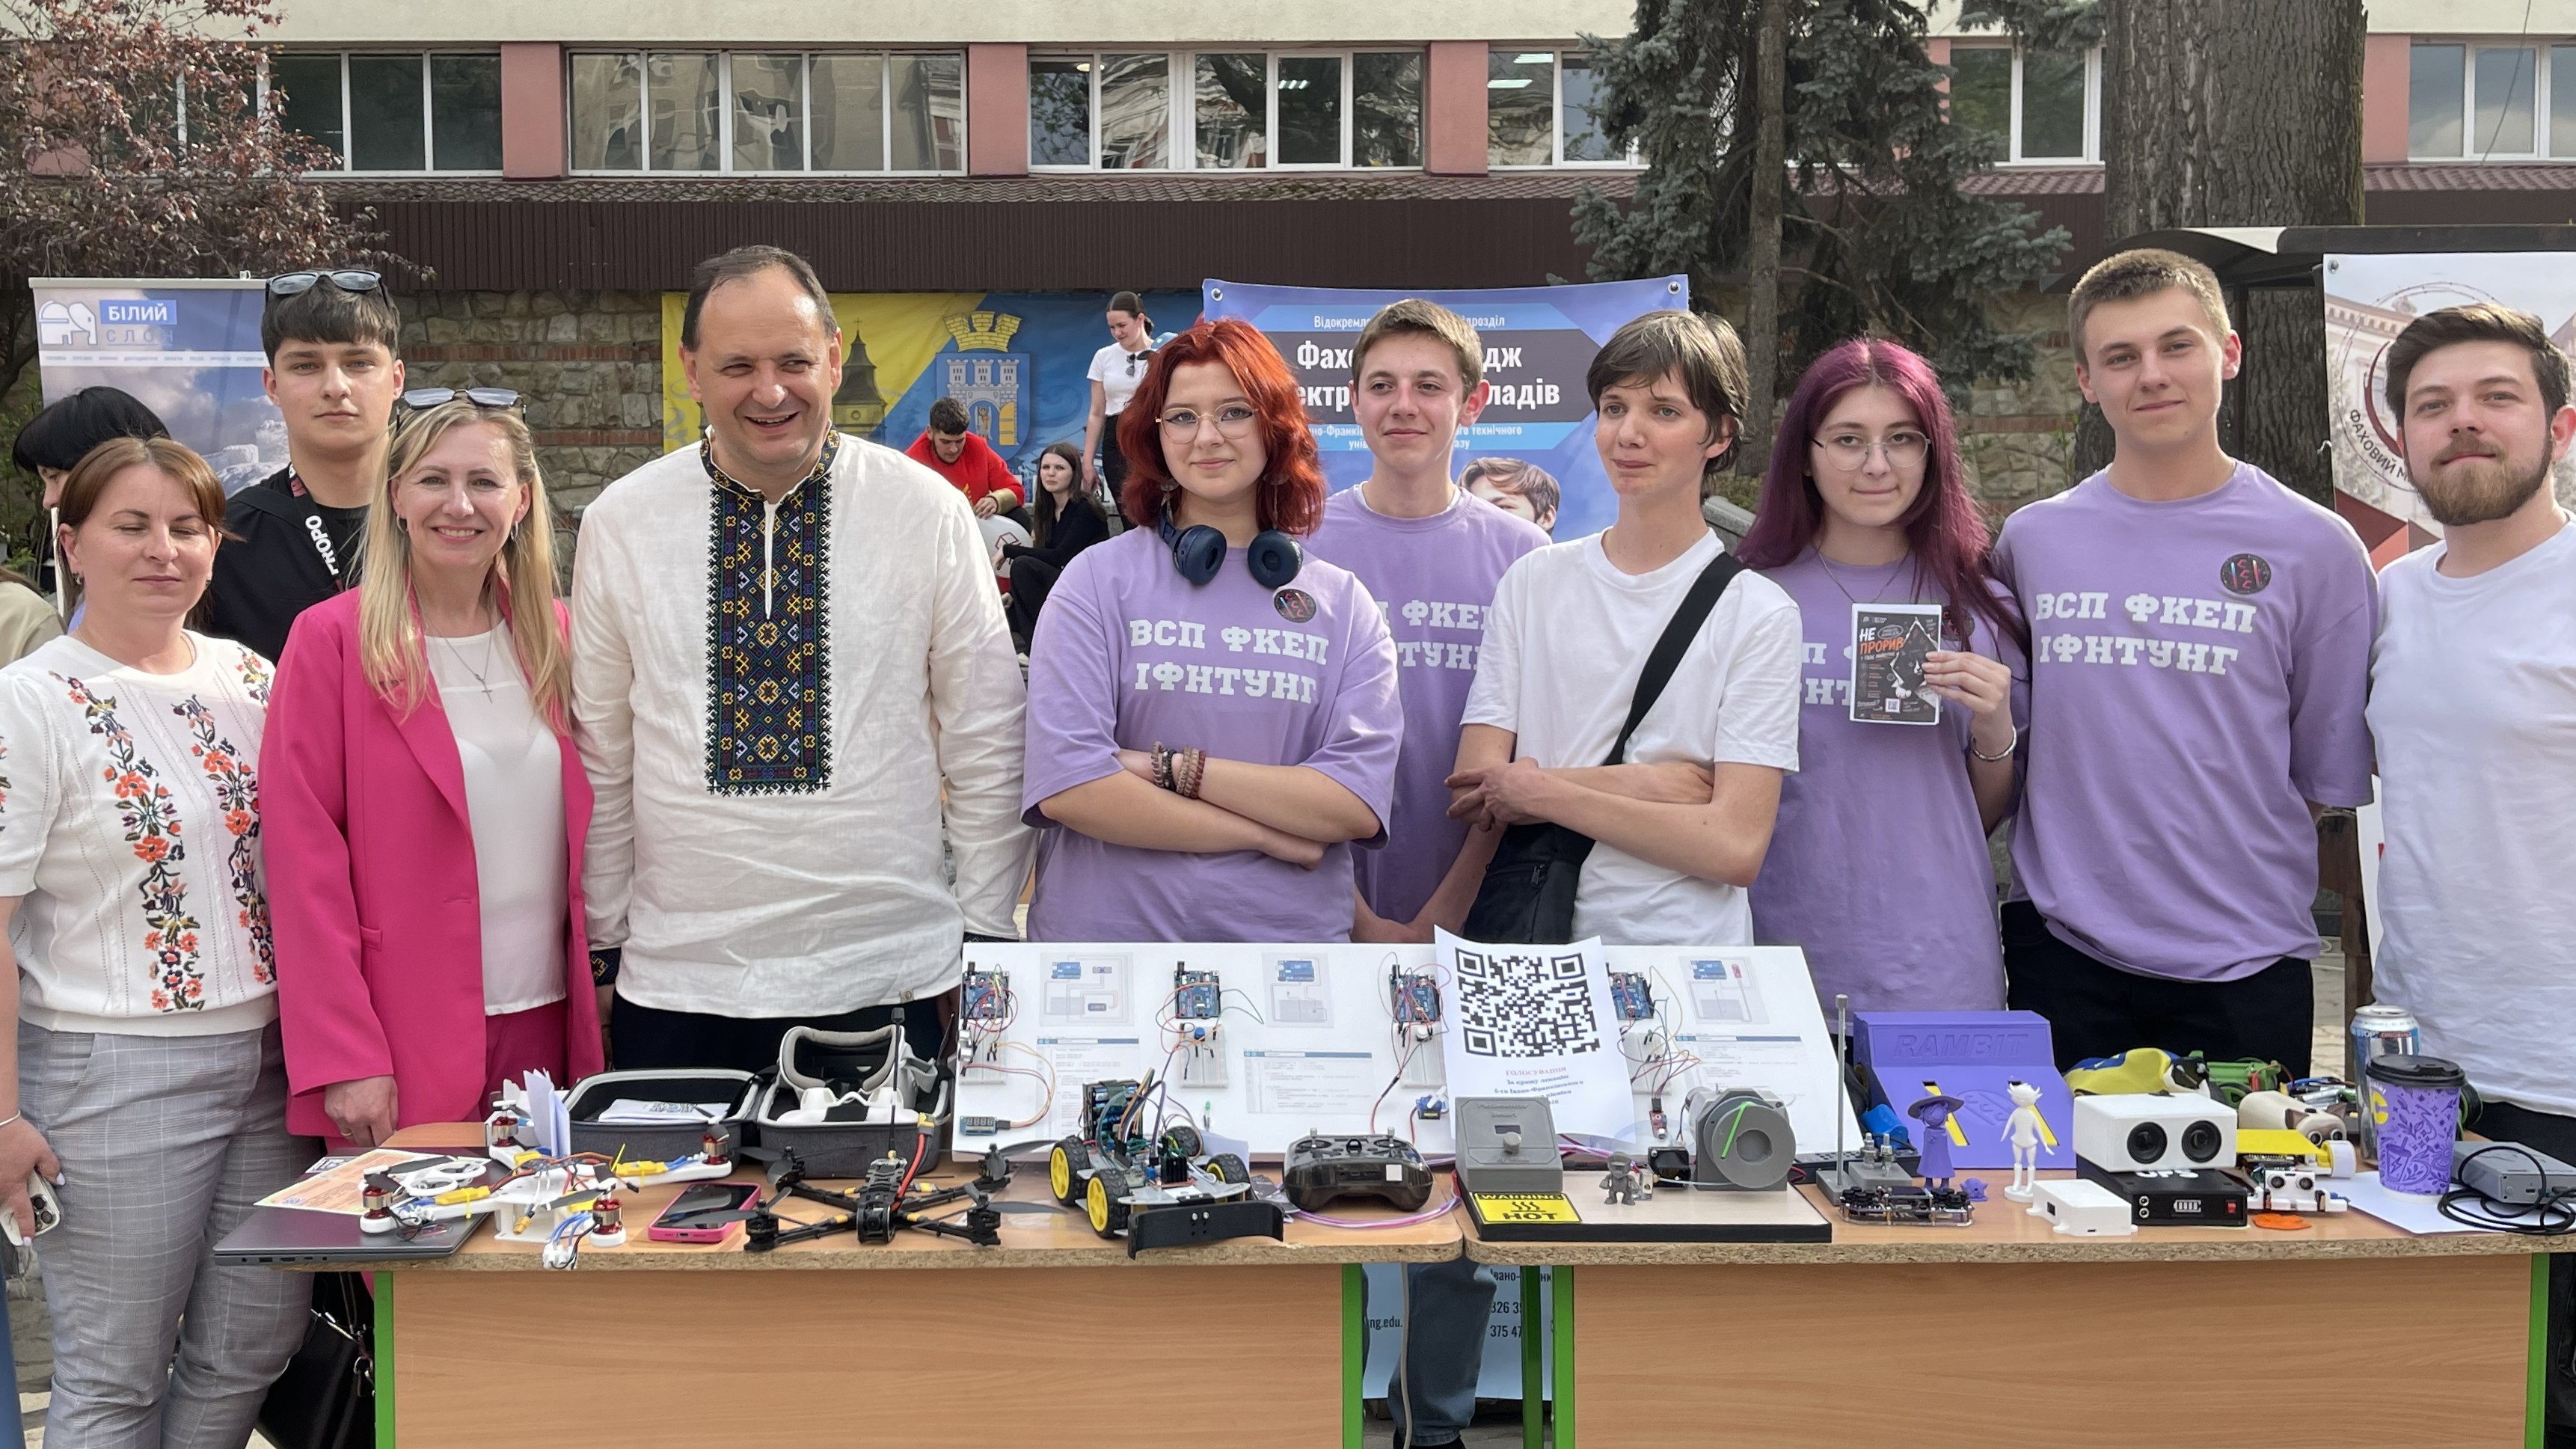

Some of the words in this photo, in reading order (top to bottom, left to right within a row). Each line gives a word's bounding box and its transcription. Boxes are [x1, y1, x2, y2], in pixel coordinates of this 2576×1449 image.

[108, 303, 168, 322] БІЛИЙ
[106, 329, 174, 343] СЛОН
[1482, 347, 1522, 373] дж
[1296, 385, 1350, 412] ектр
[1485, 378, 1560, 410] ладів
[1471, 425, 1523, 435] технічного
[1349, 438, 1368, 450] унів
[1454, 439, 1471, 450] азу
[2350, 409, 2396, 474] ФАХОВИЙ
[2035, 592, 2109, 621] ВСП
[2124, 592, 2257, 634] ФКЕП
[1129, 619, 1206, 649] ВСП
[1221, 626, 1330, 665] ФКЕП
[1859, 627, 1877, 642] НЕ
[1397, 641, 1480, 671] ТУН
[1859, 637, 1904, 655] ПРОРИВ
[2040, 634, 2239, 676] ІФНТУНГ
[1135, 661, 1316, 705] ІФНТУНГ
[1895, 1033, 2029, 1059] RAMBIT
[1502, 1212, 1558, 1220] HOT
[1370, 1315, 1403, 1331] ng.edu.
[1490, 1325, 1508, 1338] 375
